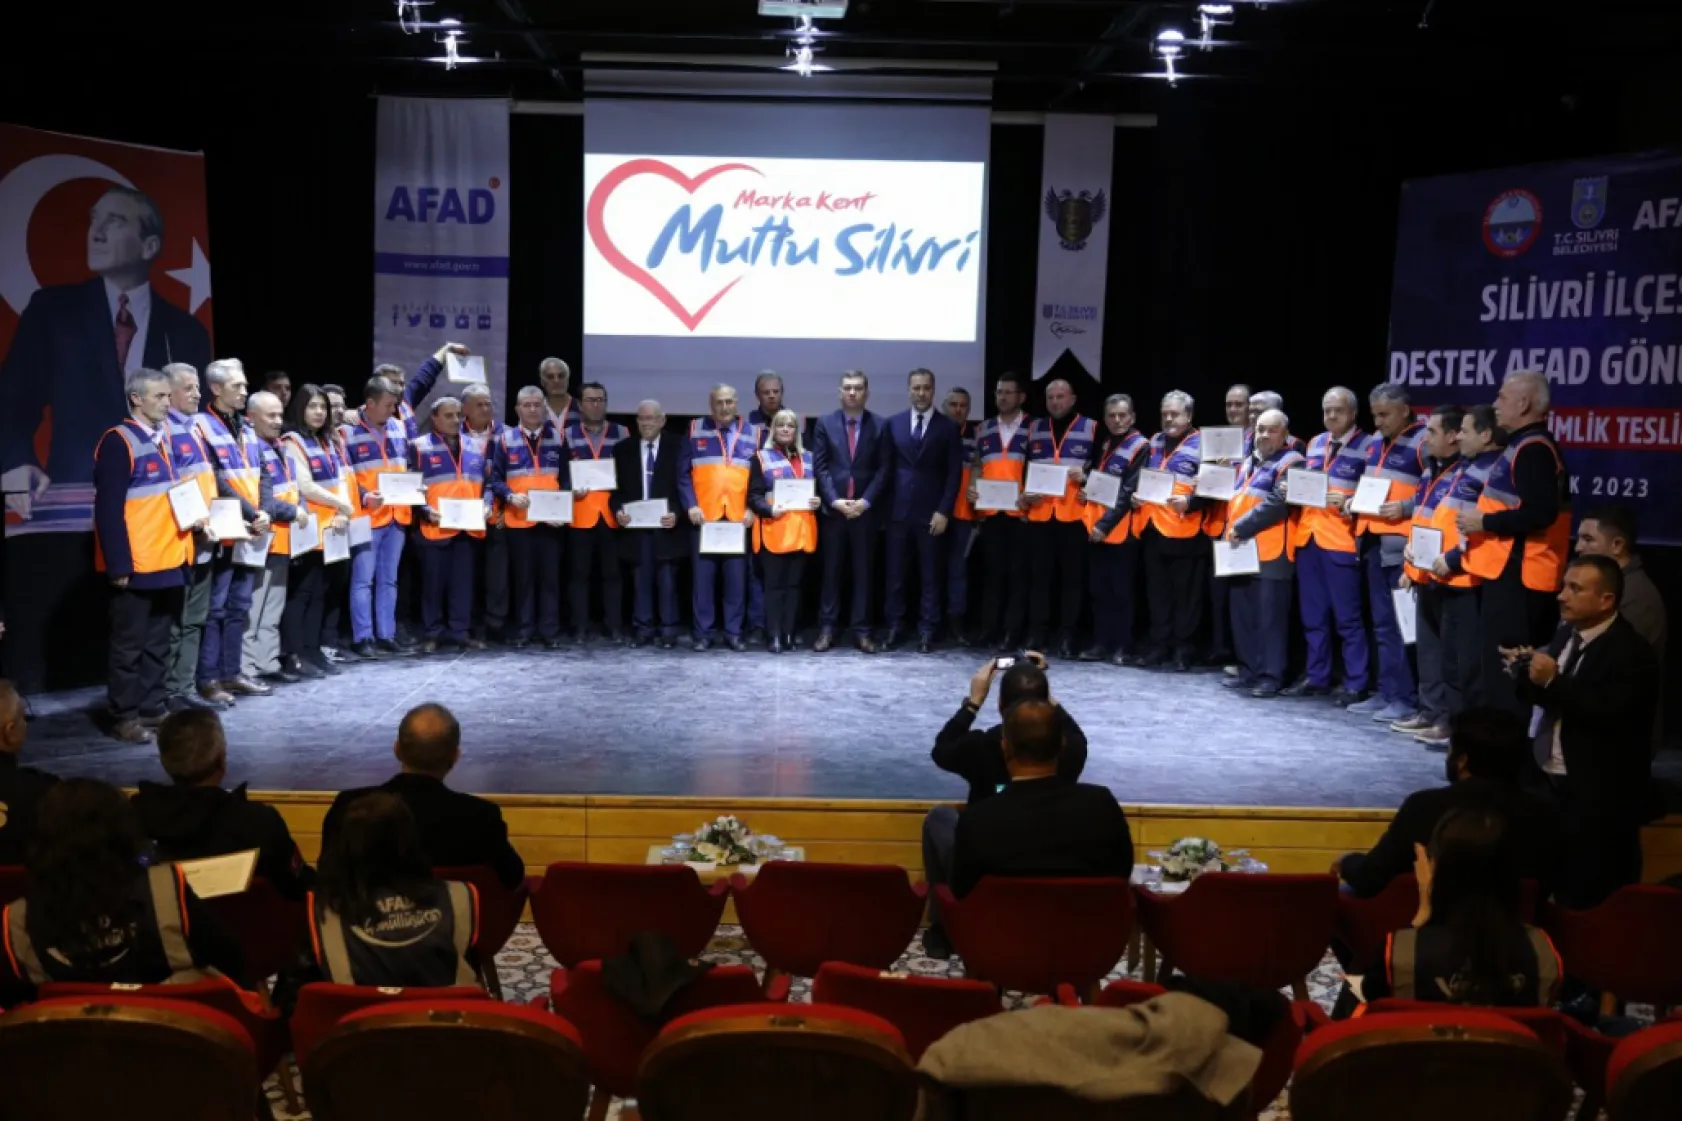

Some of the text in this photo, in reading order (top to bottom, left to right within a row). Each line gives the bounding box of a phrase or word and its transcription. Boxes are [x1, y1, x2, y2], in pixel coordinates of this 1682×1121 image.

[385, 186, 495, 225] AFAD
[732, 189, 878, 211] Marka Kent
[834, 222, 979, 276] Silivri
[1554, 232, 1573, 245] T.C.
[1480, 270, 1682, 323] SİLİVRİ İLÇE
[1389, 349, 1498, 386] DESTEK
[1548, 411, 1682, 446] İMLİK TESLİ
[1591, 477, 1649, 498] 2023
